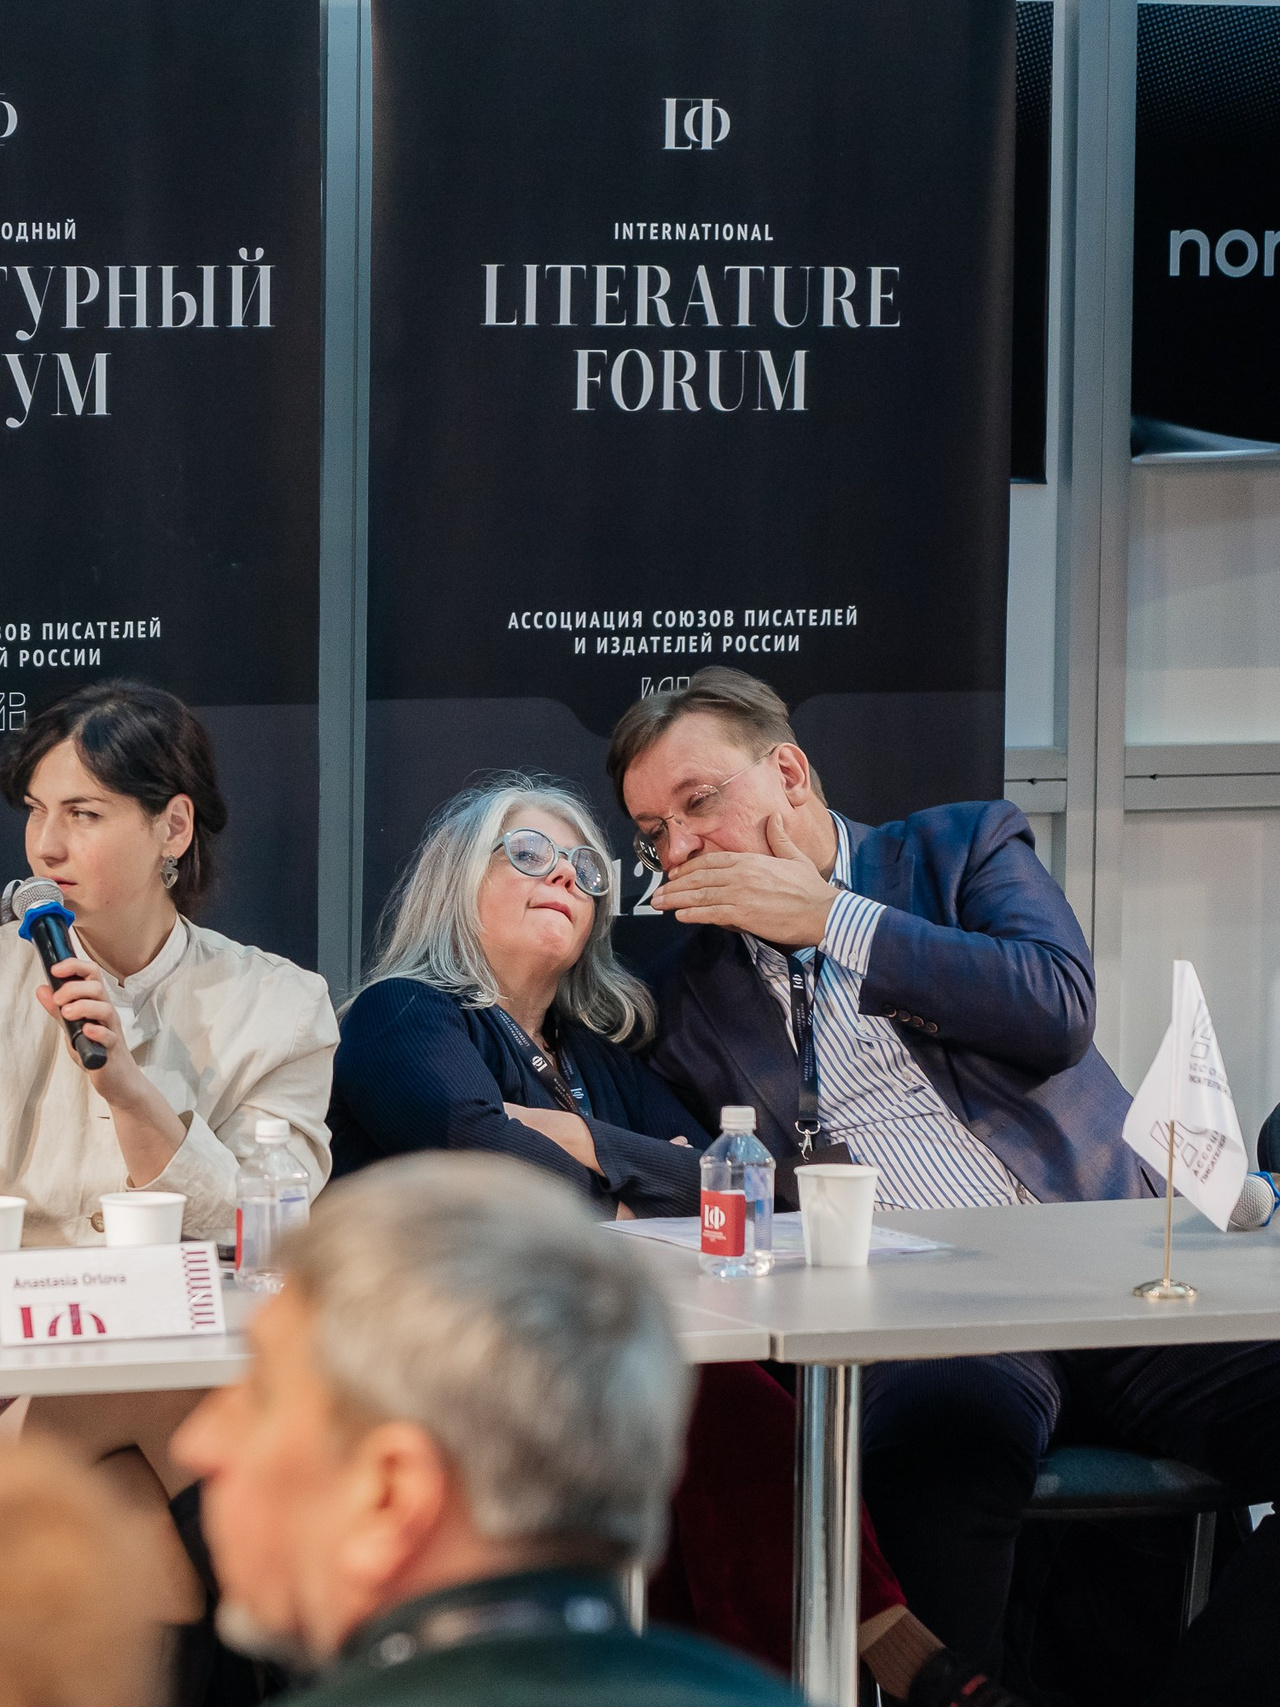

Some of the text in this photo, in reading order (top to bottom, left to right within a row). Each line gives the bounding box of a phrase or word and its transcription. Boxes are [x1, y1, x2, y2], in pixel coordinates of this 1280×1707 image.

[614, 223, 774, 242] INTERNATIONAL
[480, 264, 901, 329] LITERATURE
[572, 348, 809, 412] FORUM
[42, 617, 162, 640] ПИСАТЕЛЕЙ
[508, 606, 857, 631] АССОЦИАЦИЯ СОЮЗОВ ПИСАТЕЛЕЙ
[574, 632, 800, 656] И ИЗДАТЕЛЕЙ РОССИИ
[19, 648, 101, 667] РОССИИ
[13, 1272, 127, 1290] Anastasia Orlova
